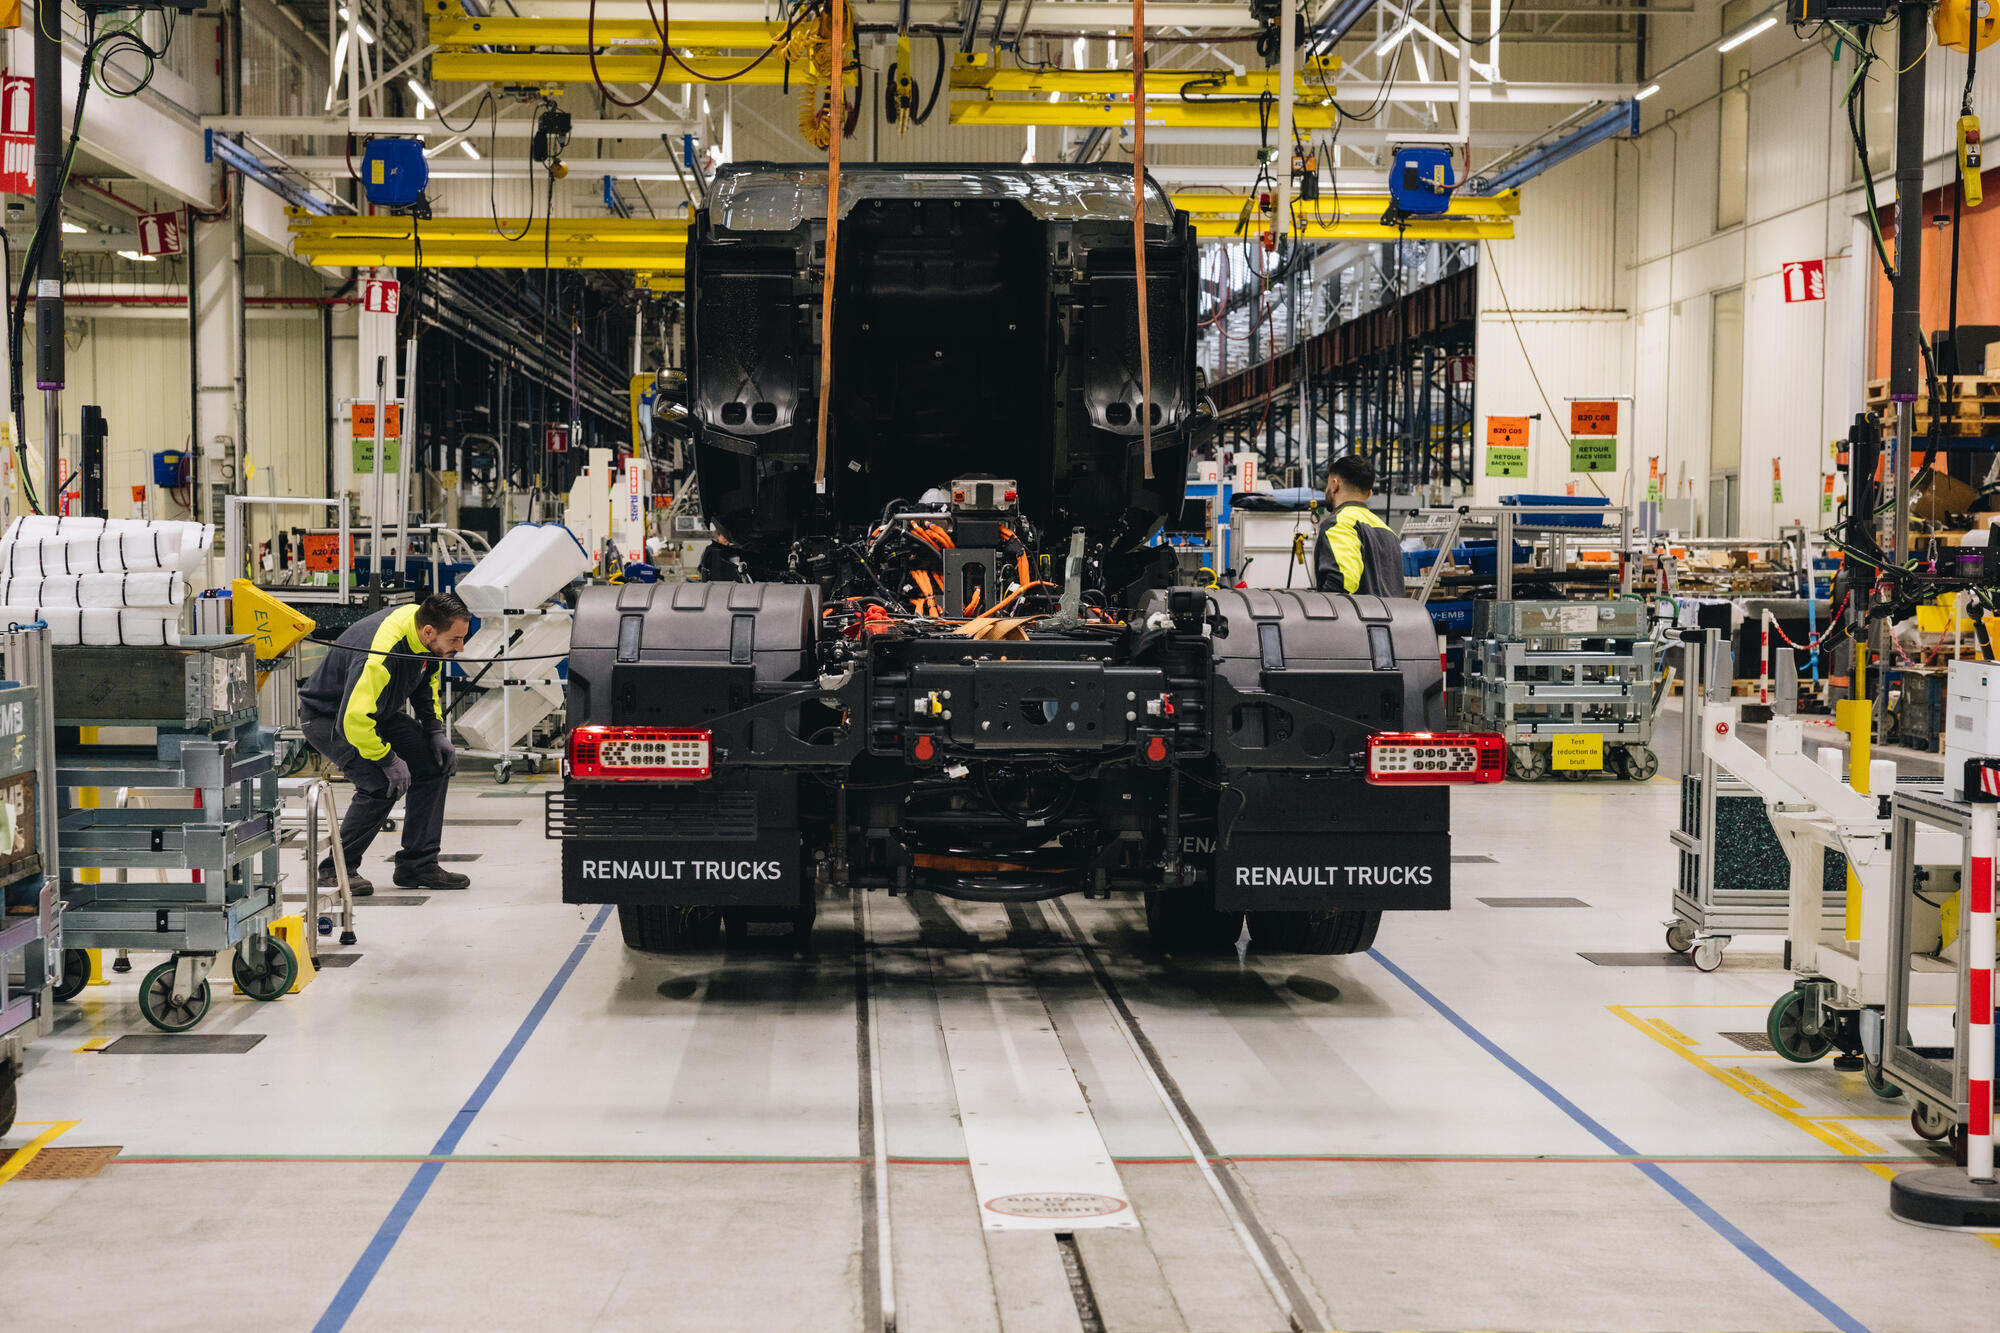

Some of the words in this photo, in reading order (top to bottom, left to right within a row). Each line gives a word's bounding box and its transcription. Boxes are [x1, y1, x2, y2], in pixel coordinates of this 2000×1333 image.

[630, 466, 638, 494] KONI
[1243, 461, 1253, 493] KONI
[630, 495, 639, 522] stertil
[1431, 611, 1465, 619] V-EMB
[1541, 607, 1616, 620] V-B
[254, 609, 273, 648] EVF
[582, 860, 686, 880] RENAULT
[691, 861, 782, 880] TRUCKS
[1235, 866, 1339, 886] RENAULT
[1344, 865, 1433, 886] TRUCKS
